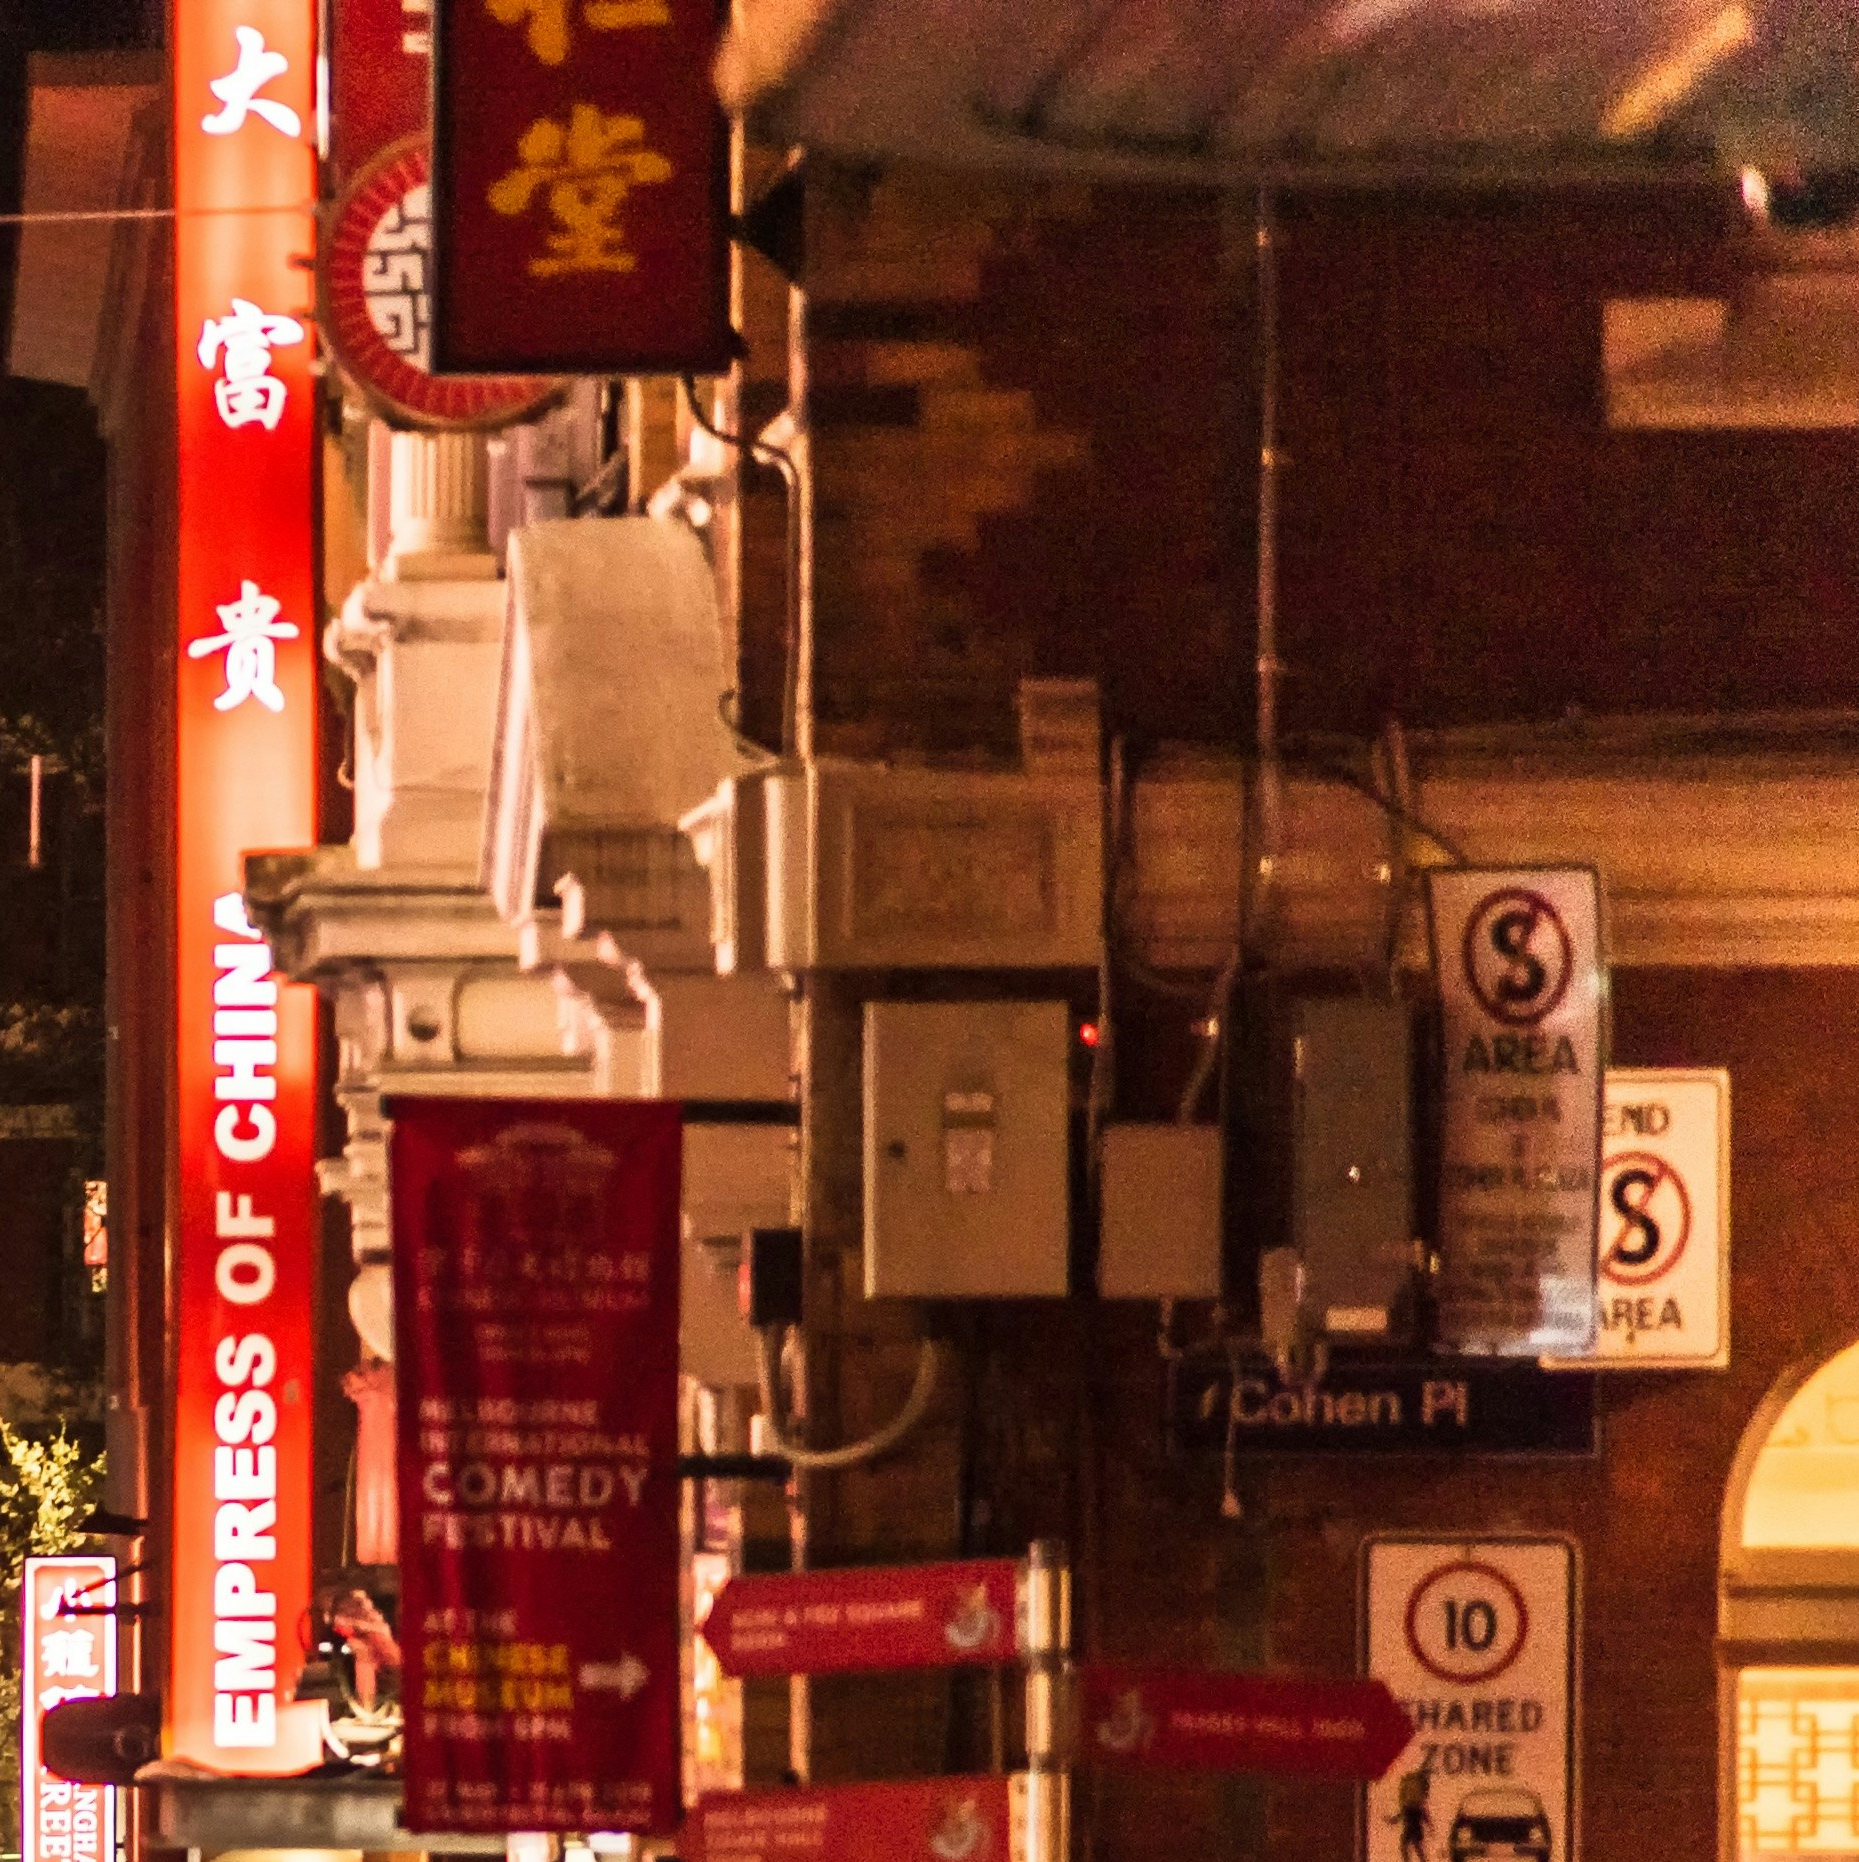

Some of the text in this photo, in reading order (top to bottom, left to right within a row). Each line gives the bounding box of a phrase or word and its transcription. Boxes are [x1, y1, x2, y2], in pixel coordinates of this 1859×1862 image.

[189, 25, 304, 714] 大富貴
[1462, 1034, 1579, 1076] AREA
[213, 891, 278, 1748] EMPRESS OF CHINA
[1232, 1377, 1403, 1426] Cohen
[422, 1461, 649, 1507] COMEDY
[421, 1513, 612, 1552] FESTIVAL
[1445, 1599, 1498, 1651] 10
[1423, 1743, 1515, 1777] ZONE
